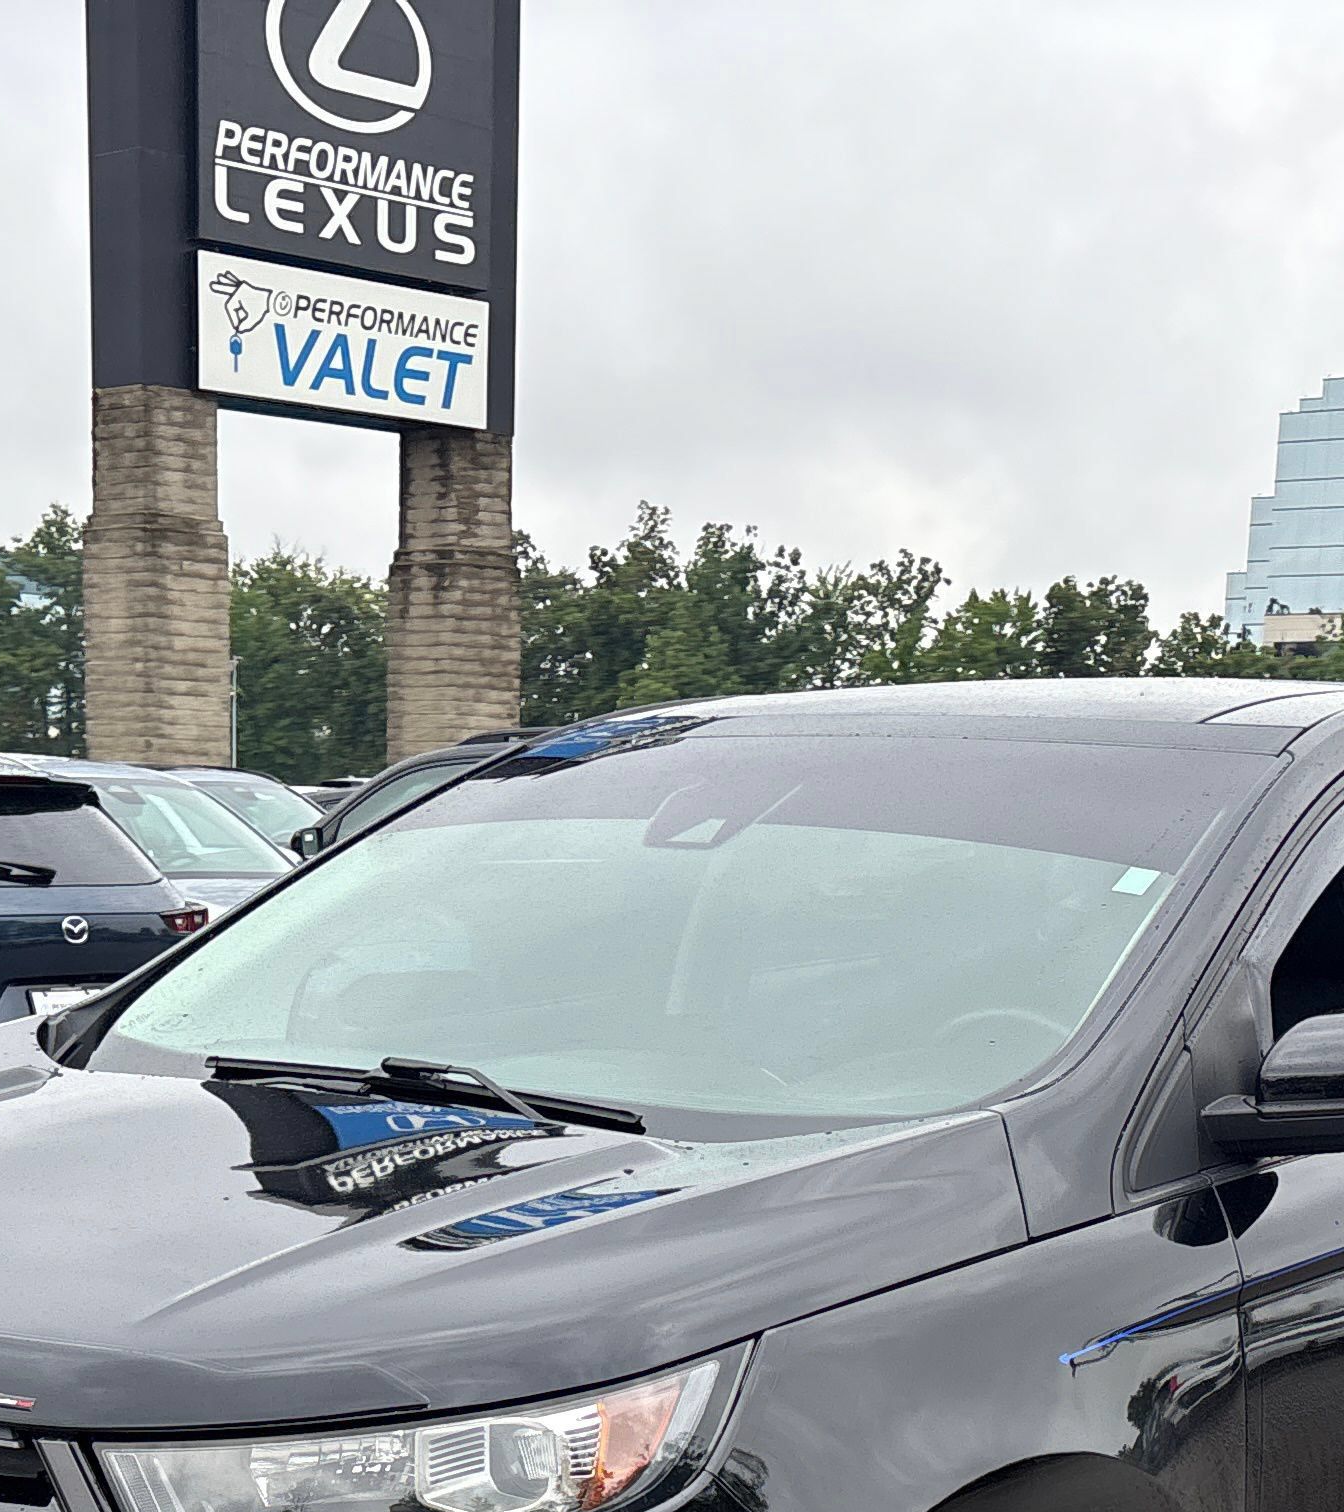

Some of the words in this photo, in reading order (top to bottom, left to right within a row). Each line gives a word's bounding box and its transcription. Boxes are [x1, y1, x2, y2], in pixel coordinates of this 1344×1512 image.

[216, 120, 474, 208] PERFORMANCE
[214, 165, 476, 265] LEXUS
[293, 295, 479, 347] PERFORMANCE
[273, 323, 473, 409] VALET
